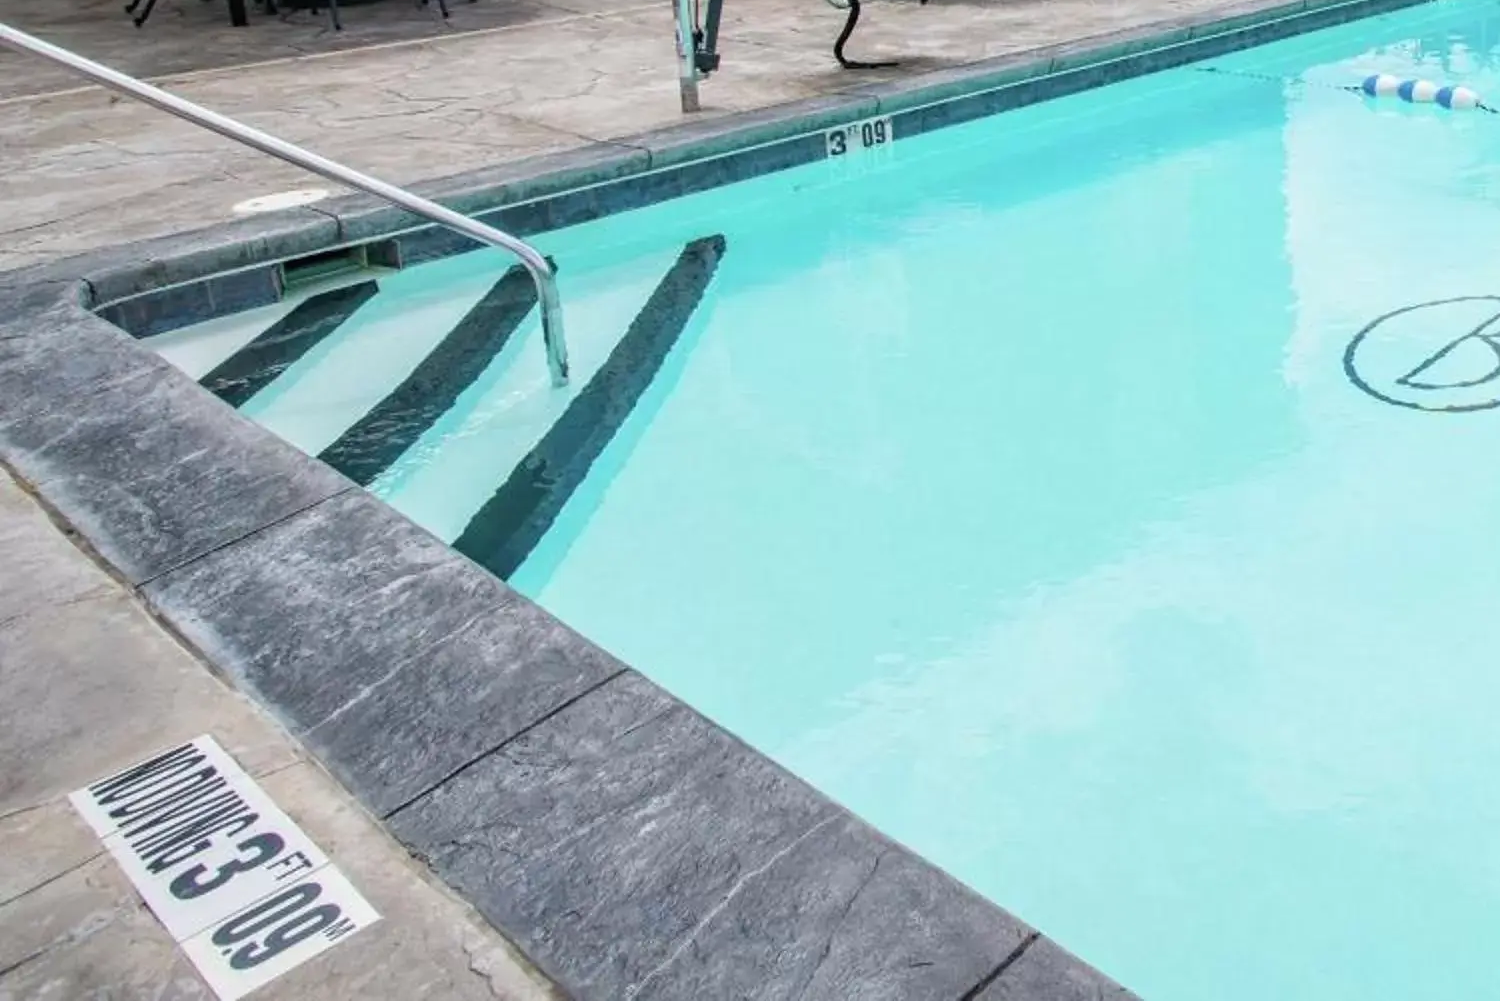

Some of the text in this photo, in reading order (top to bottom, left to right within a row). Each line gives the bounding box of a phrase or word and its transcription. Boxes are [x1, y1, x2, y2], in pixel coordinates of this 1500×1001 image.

[829, 130, 847, 155] 3
[88, 742, 260, 874] NO DIVING
[169, 832, 313, 900] 3 FT
